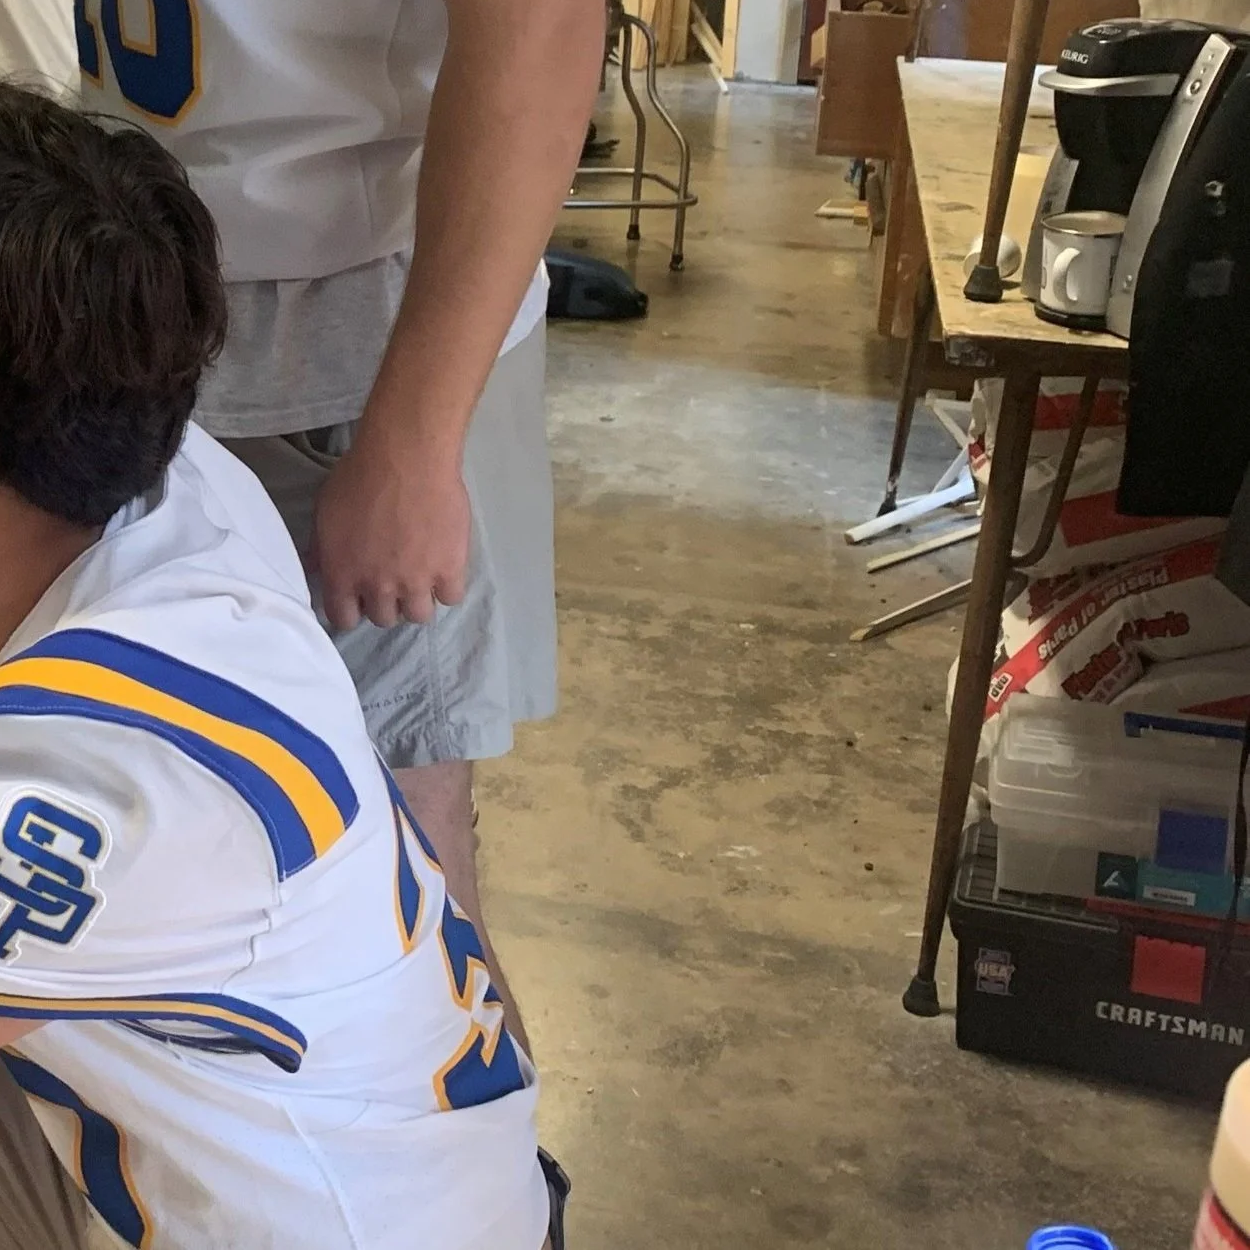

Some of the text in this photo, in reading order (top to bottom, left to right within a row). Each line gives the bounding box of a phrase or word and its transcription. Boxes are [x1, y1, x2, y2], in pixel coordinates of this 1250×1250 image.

[1061, 49, 1089, 65] KEURIG
[1037, 616, 1079, 660] Paris
[1095, 1001, 1246, 1046] CRAFTSMAN
